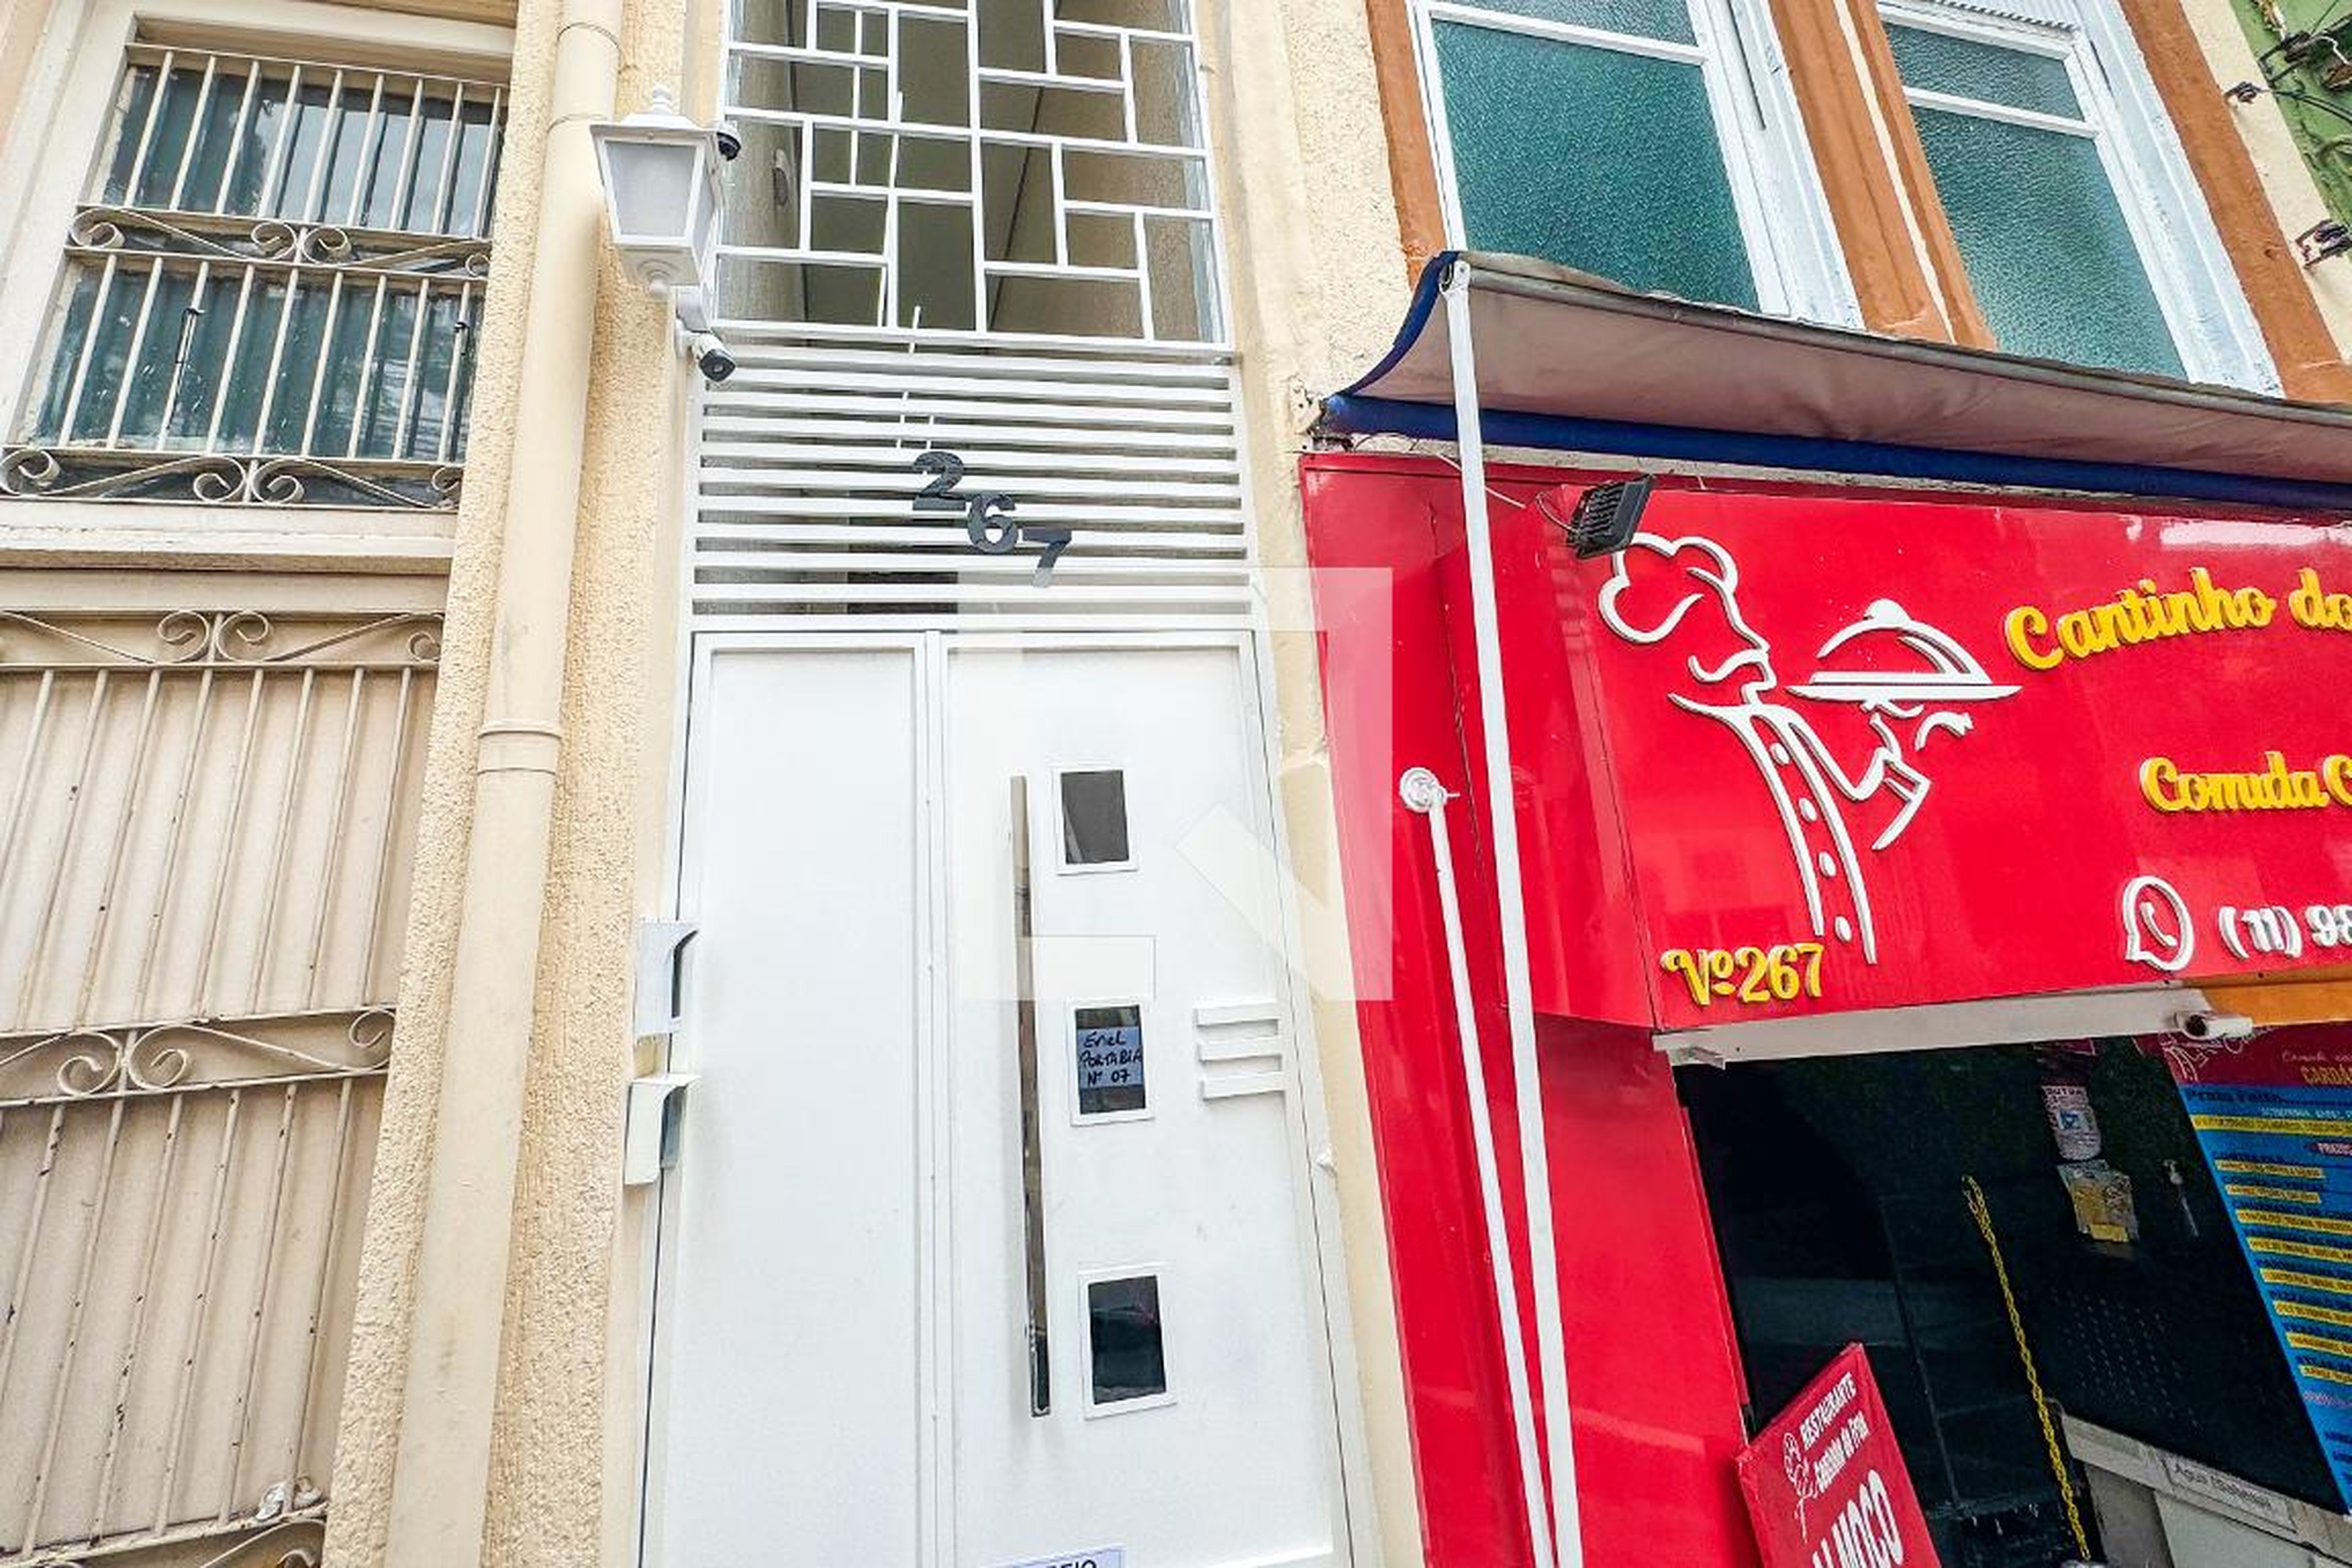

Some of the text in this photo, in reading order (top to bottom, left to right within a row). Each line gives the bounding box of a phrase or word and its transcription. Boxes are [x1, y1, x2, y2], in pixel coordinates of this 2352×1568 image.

[912, 451, 1073, 588] 267
[2005, 567, 2277, 670] Cantinho
[2139, 750, 2329, 813] Comida
[2218, 905, 2302, 959] (11)
[1110, 1068, 1131, 1083] 07
[1800, 1371, 1857, 1451] RESTAURANTE
